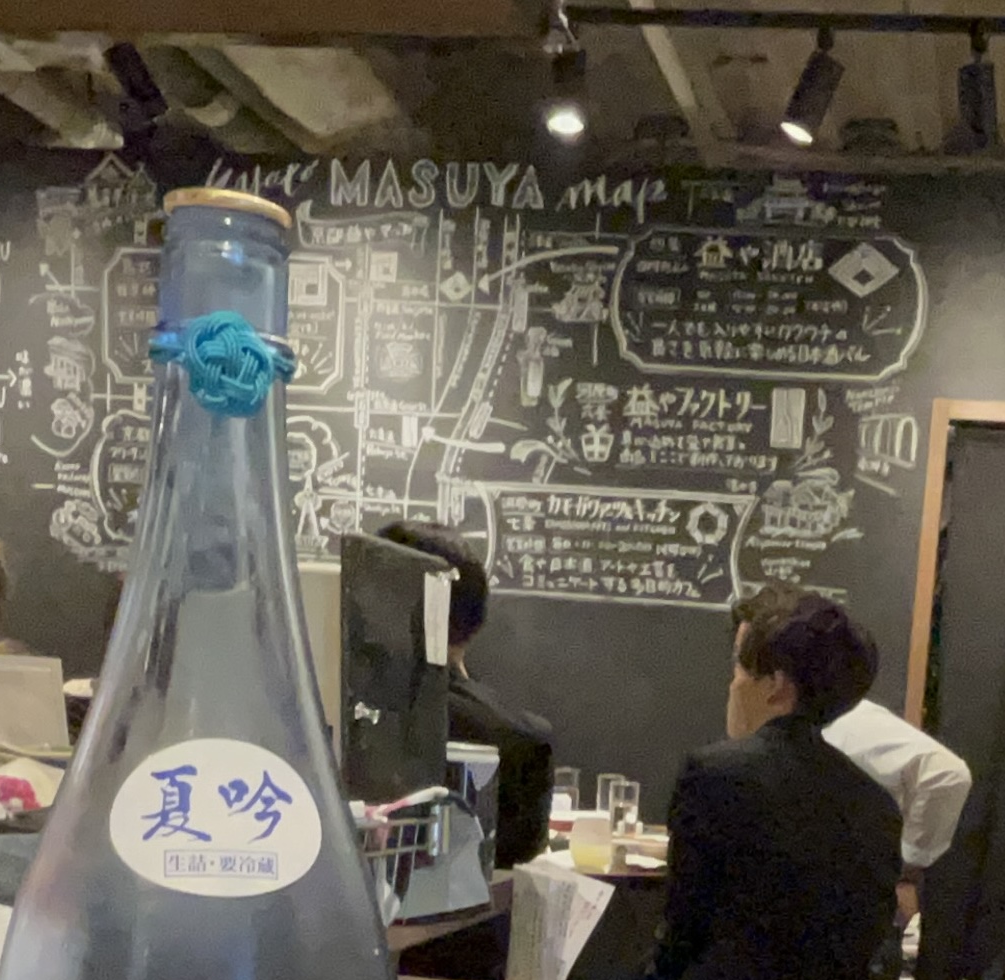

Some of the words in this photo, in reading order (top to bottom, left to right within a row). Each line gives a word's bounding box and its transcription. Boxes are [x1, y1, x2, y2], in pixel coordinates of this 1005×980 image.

[331, 158, 544, 208] MASUYA
[141, 765, 293, 845] 夏吟
[167, 853, 276, 876] 生詰・要冷蔵
